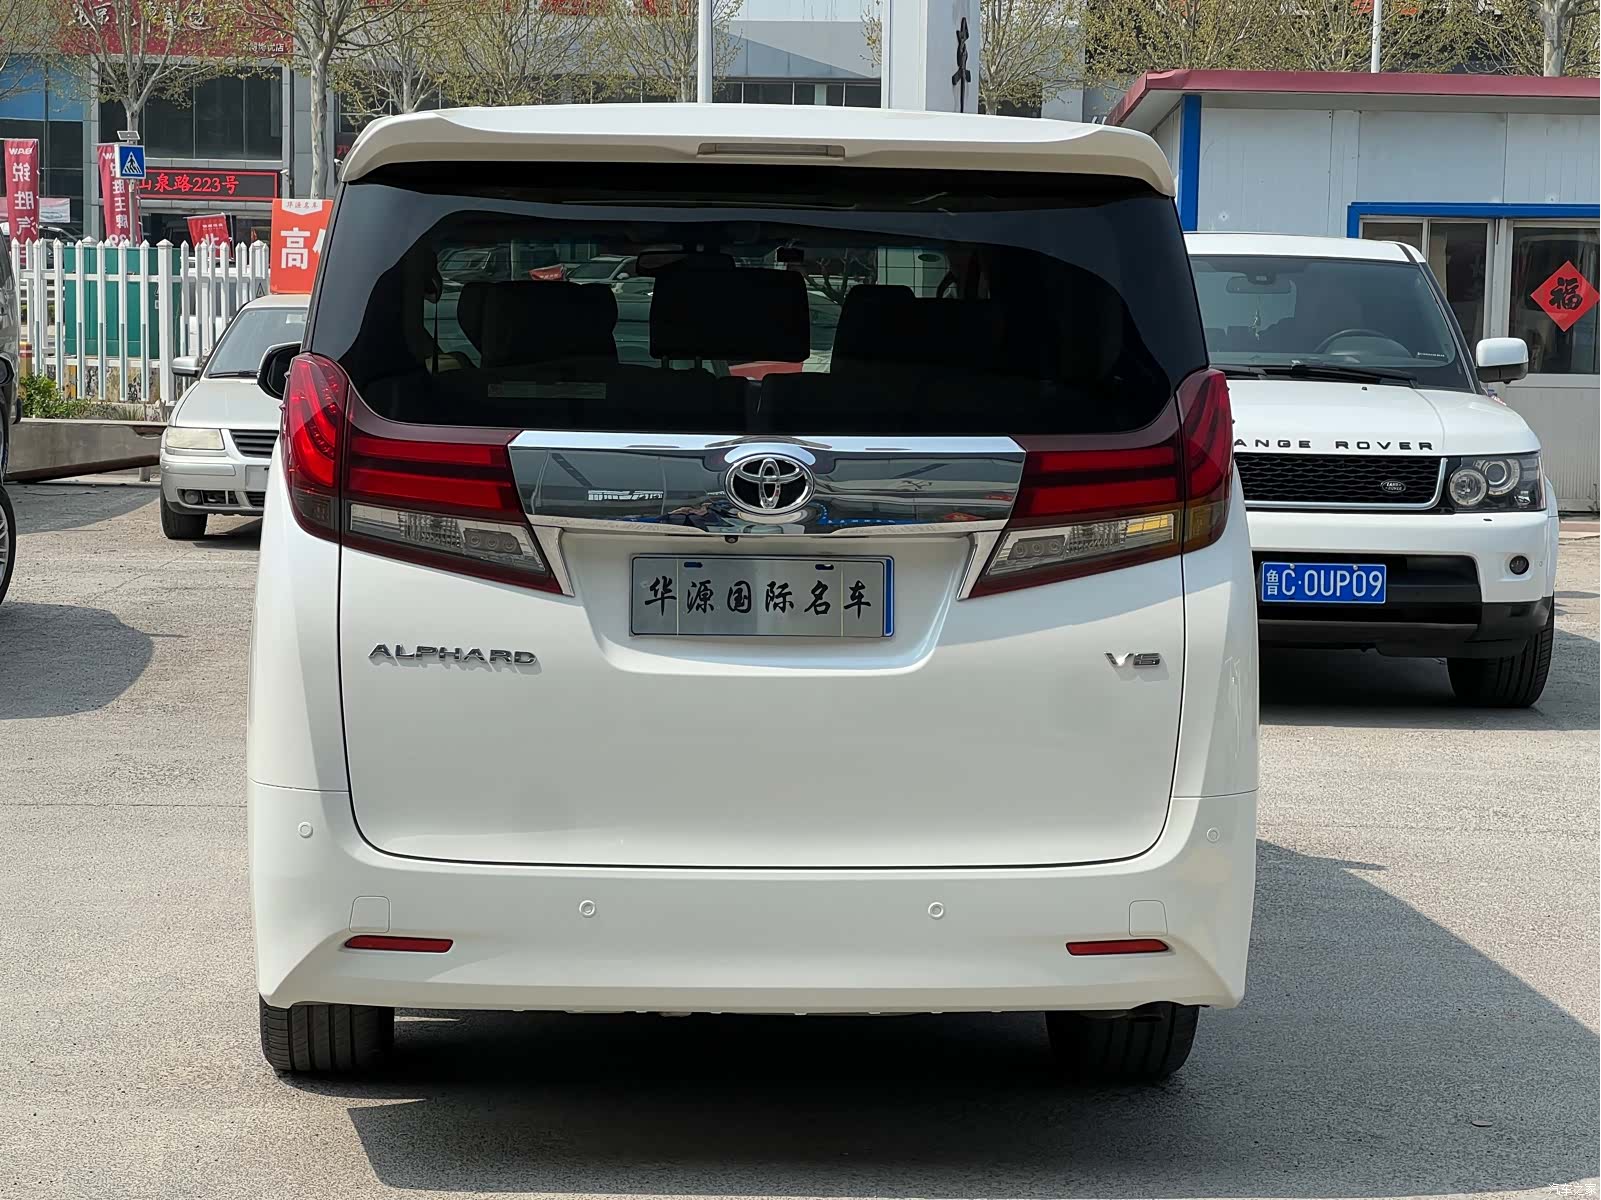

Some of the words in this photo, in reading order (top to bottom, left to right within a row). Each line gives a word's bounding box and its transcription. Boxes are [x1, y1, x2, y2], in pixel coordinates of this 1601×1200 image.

[139, 173, 239, 194] 山泉路223号
[1549, 277, 1583, 310] 福
[1234, 439, 1311, 449] ANGE
[1335, 441, 1433, 451] ROVER
[644, 576, 872, 619] 华源国际名车
[368, 643, 538, 665] ALPHARD
[1104, 652, 1161, 667] V6
